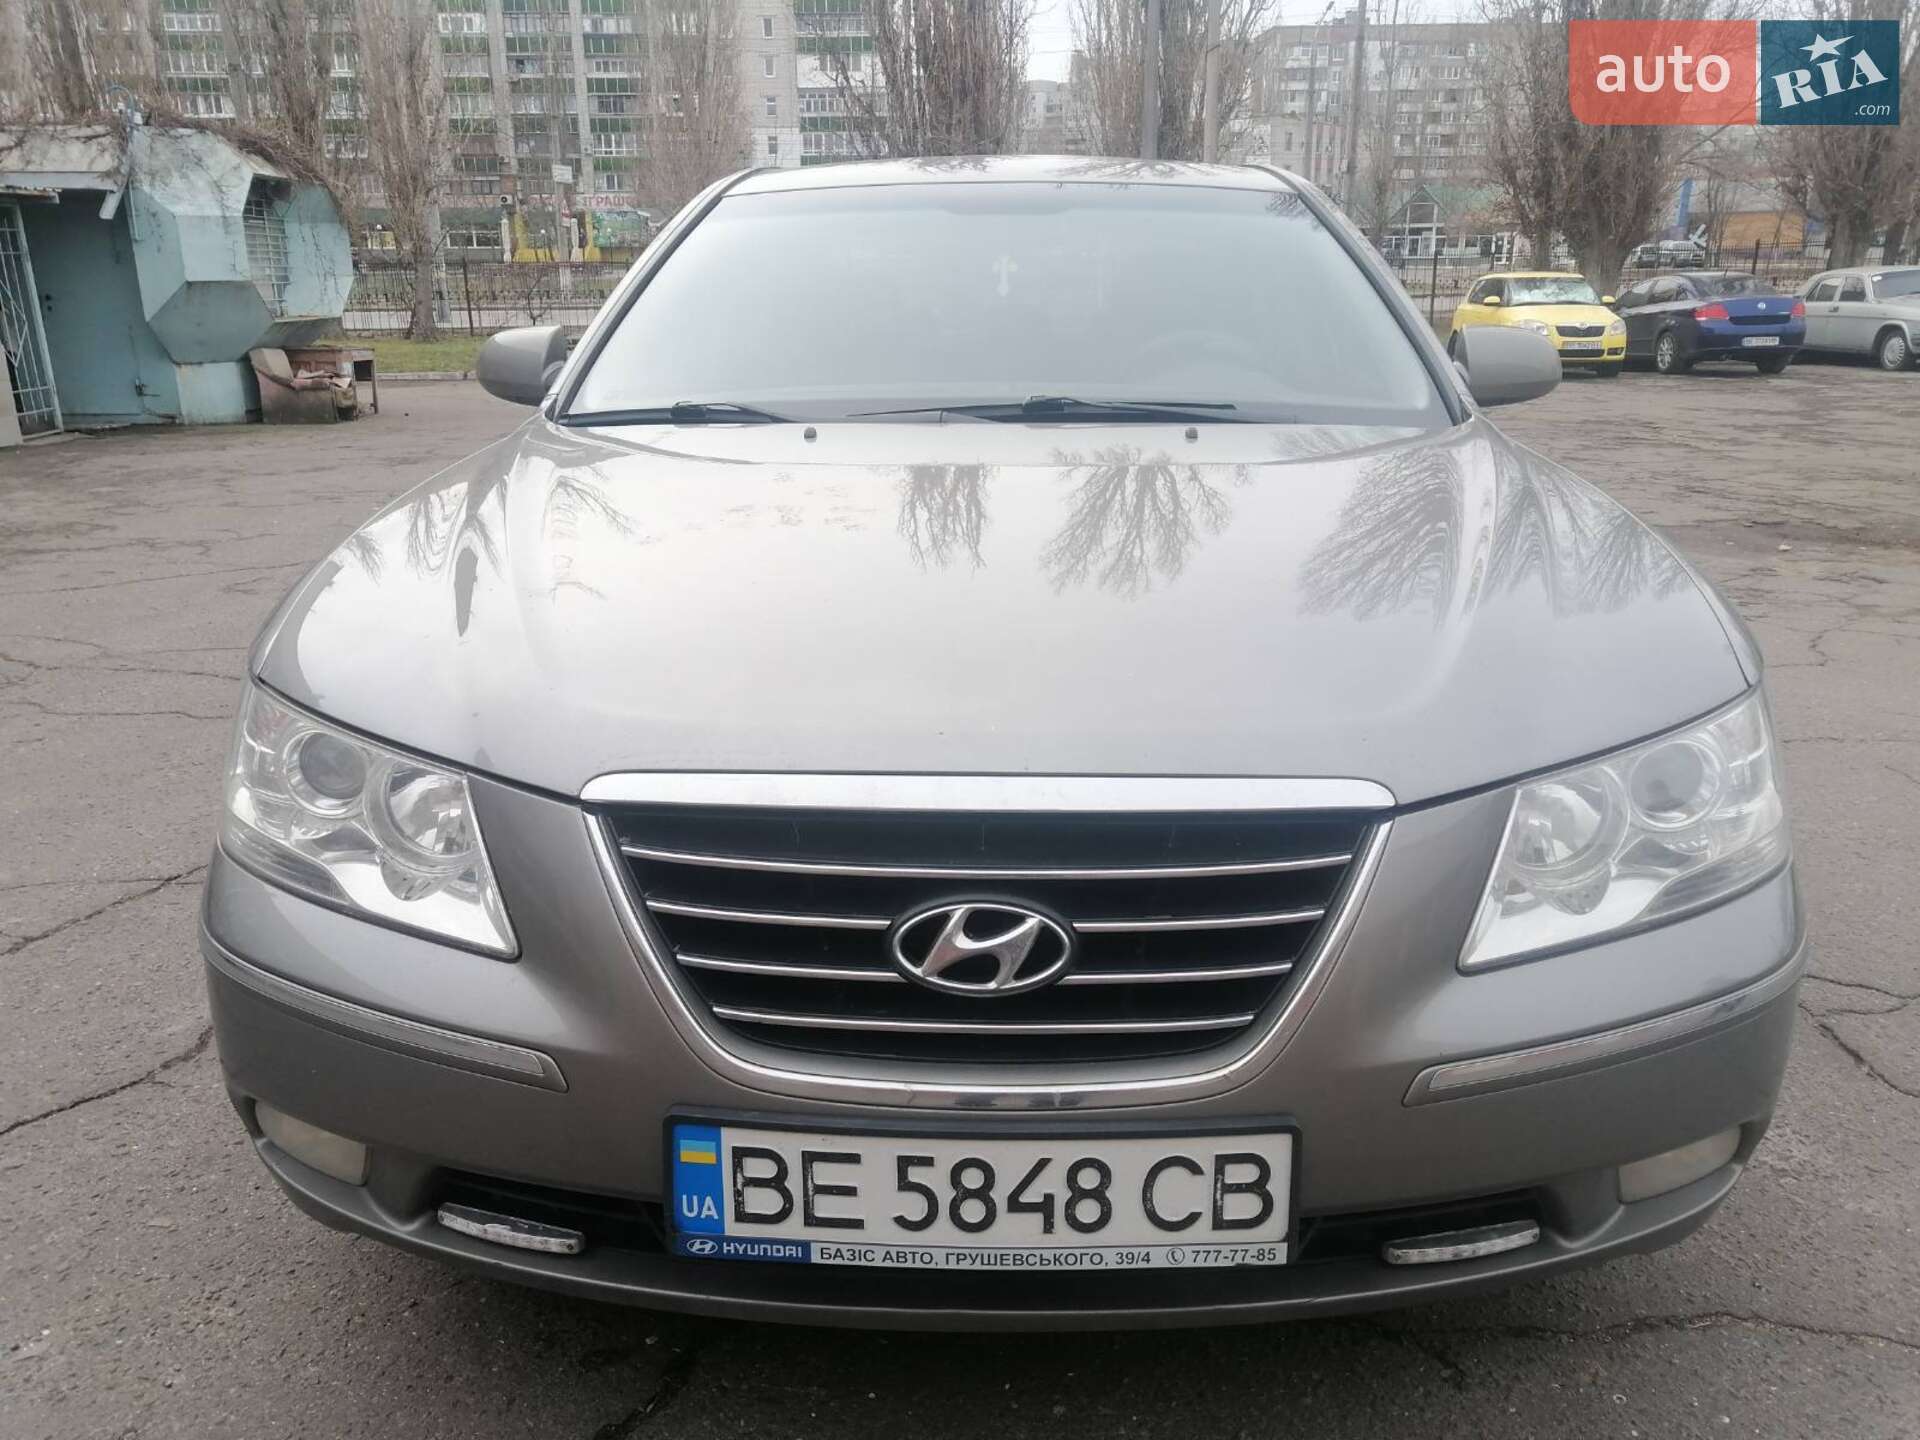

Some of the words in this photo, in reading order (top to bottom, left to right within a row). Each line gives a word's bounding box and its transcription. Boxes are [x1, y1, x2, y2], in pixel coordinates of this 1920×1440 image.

[732, 1146, 864, 1229] BE
[893, 1155, 1112, 1234] 5848
[1142, 1153, 1274, 1231] CB
[682, 1195, 718, 1219] UA
[722, 1242, 802, 1257] HYUNDAI
[820, 1247, 876, 1262] БАЗІС
[881, 1250, 938, 1266] АВТО,
[945, 1252, 1109, 1267] ГРУШЕВСЬКОГО,
[1115, 1251, 1151, 1265] 39/4
[1191, 1248, 1277, 1263] 777-77-85
